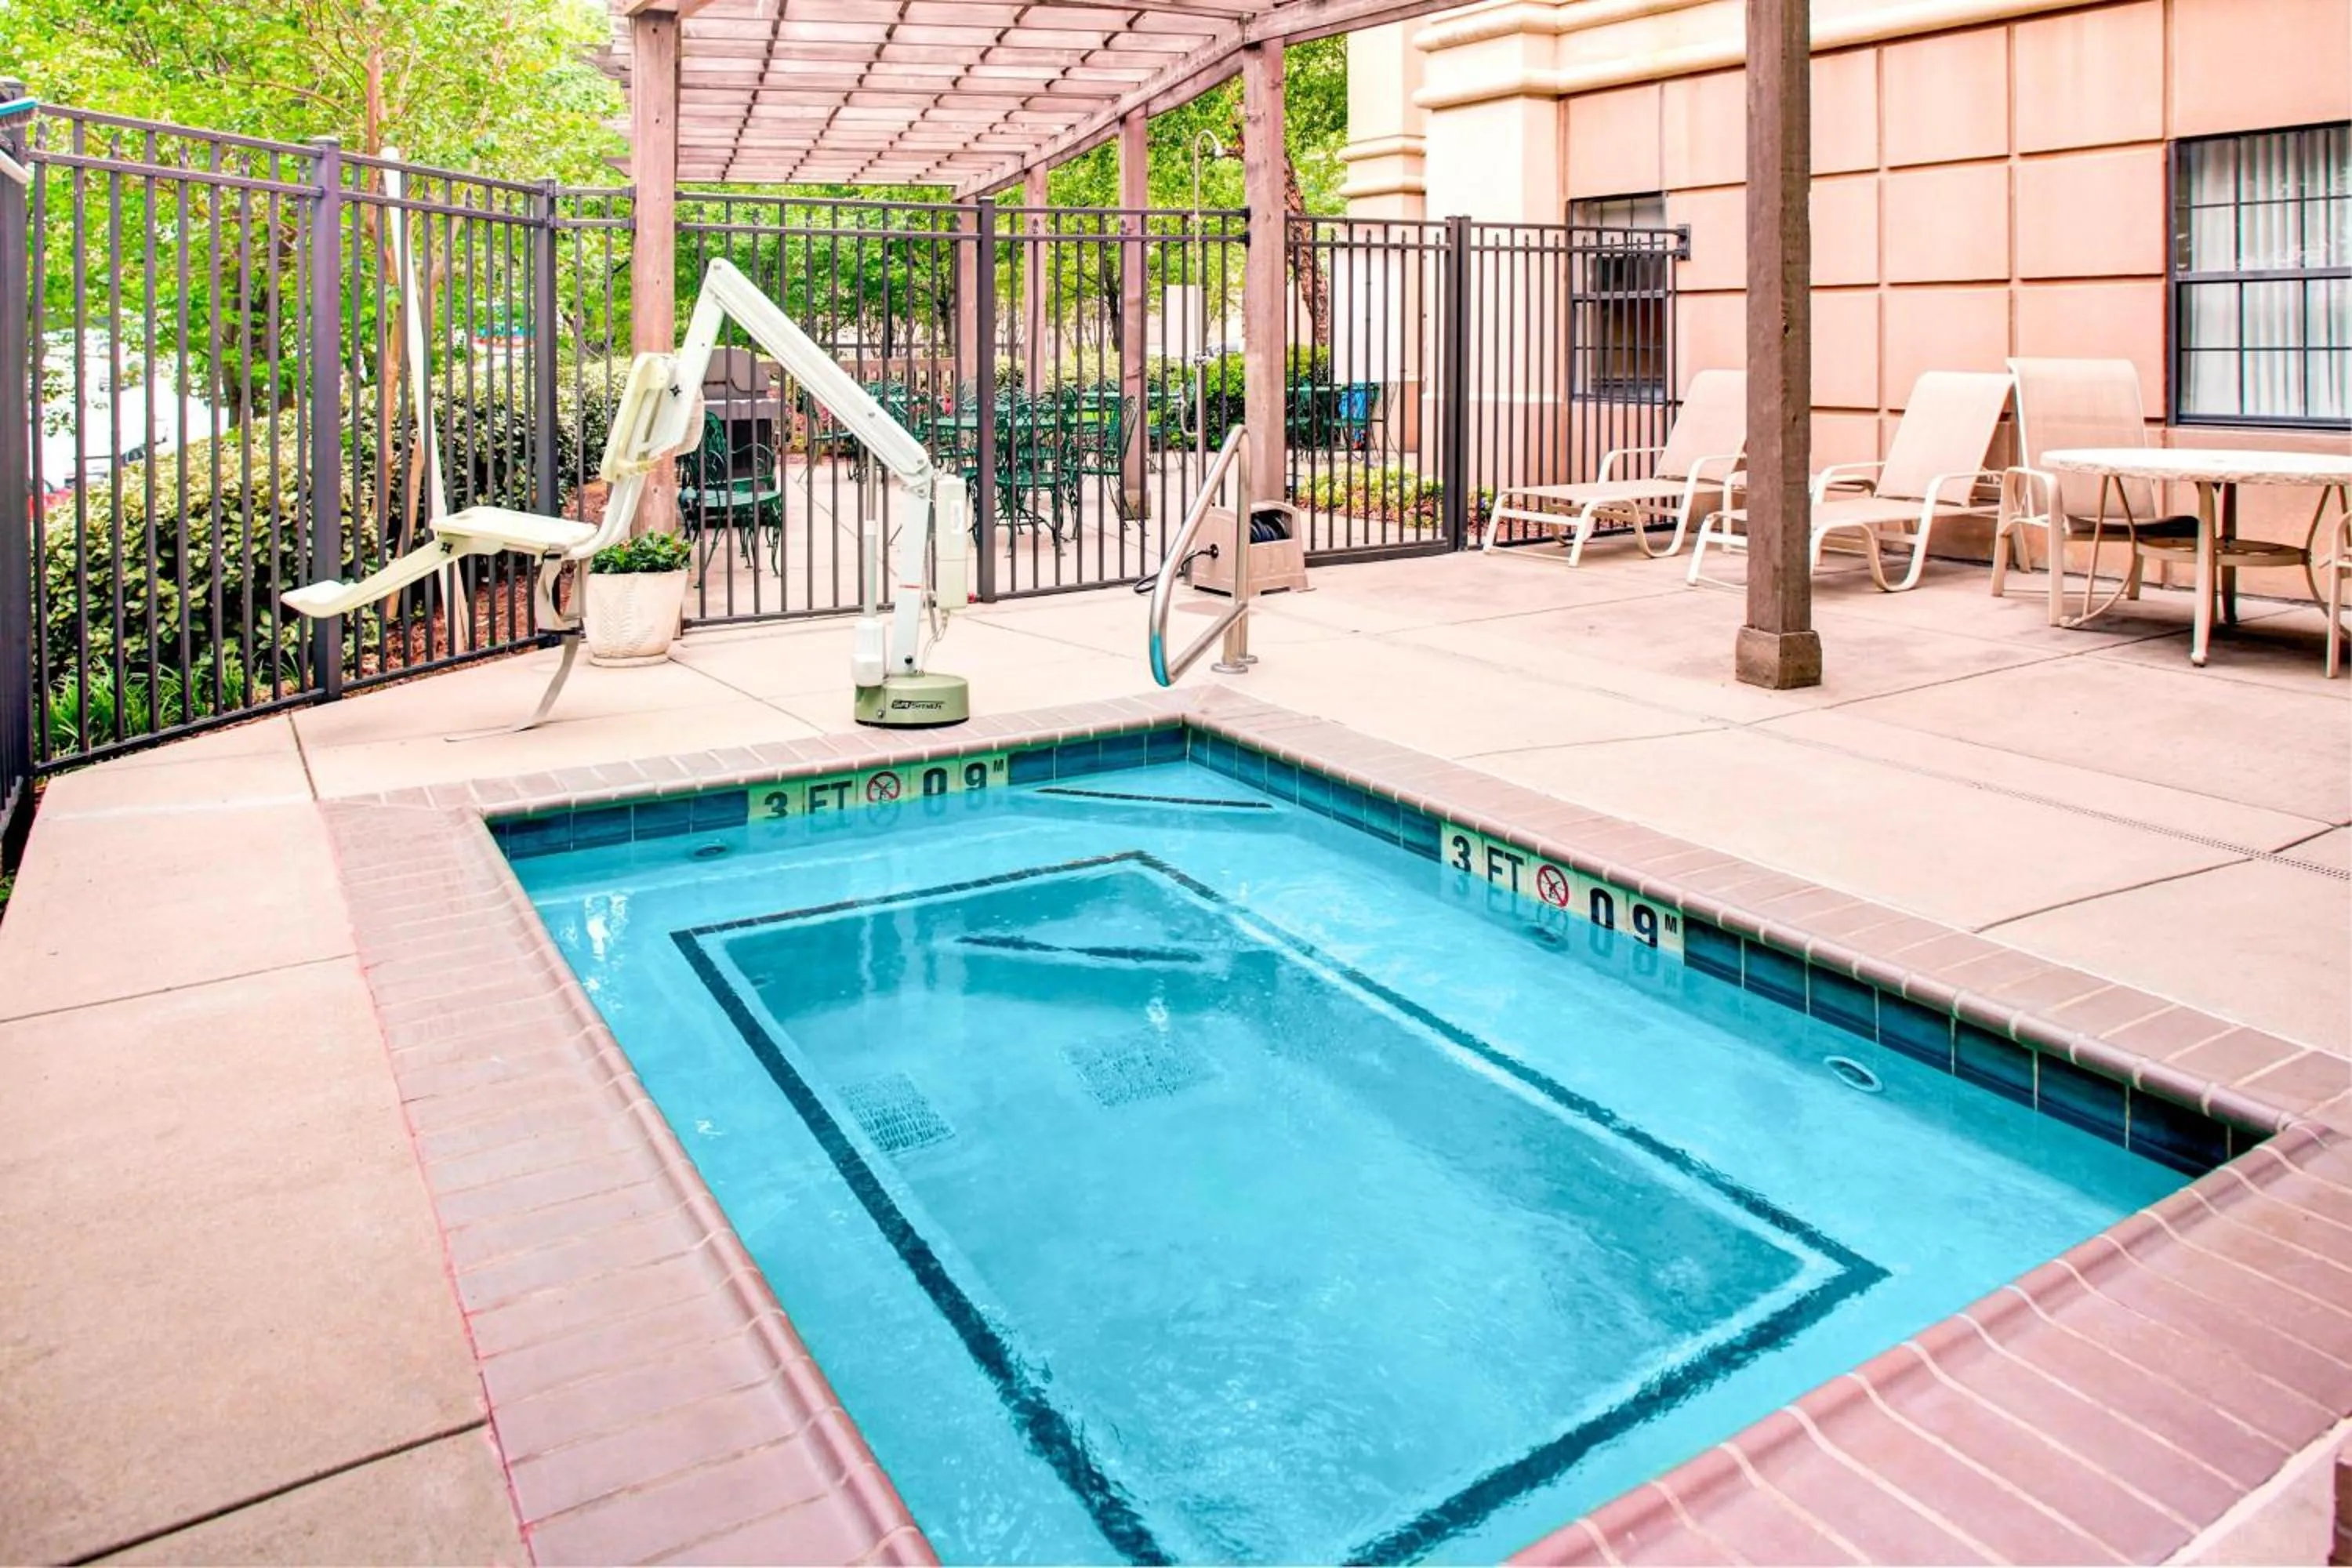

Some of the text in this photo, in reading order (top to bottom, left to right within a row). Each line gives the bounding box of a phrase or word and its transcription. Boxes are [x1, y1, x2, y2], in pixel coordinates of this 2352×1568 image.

[764, 791, 788, 819] 3
[809, 780, 853, 815] FT
[1452, 835, 1471, 872] 3
[1487, 845, 1524, 891] FT
